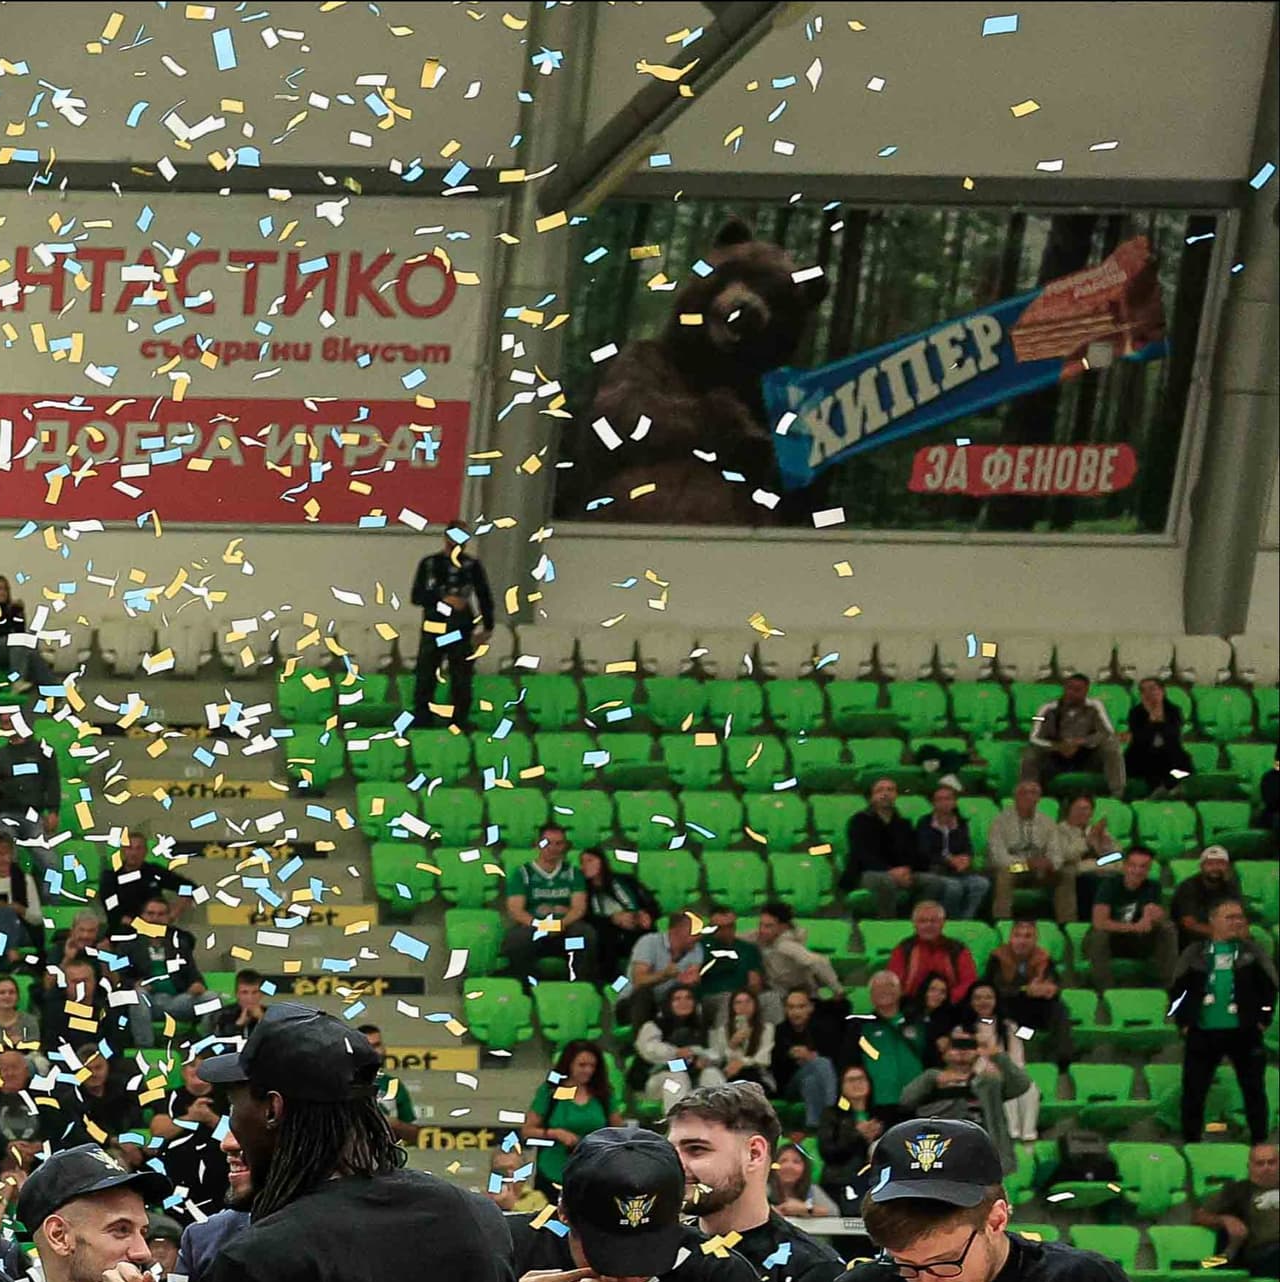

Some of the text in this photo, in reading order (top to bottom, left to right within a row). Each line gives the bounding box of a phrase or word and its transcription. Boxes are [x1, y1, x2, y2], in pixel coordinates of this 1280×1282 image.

[790, 314, 1003, 468] ХИПЕР
[924, 446, 1121, 493] ЗА ФЕНОВЕ
[417, 1126, 494, 1150] fbet
